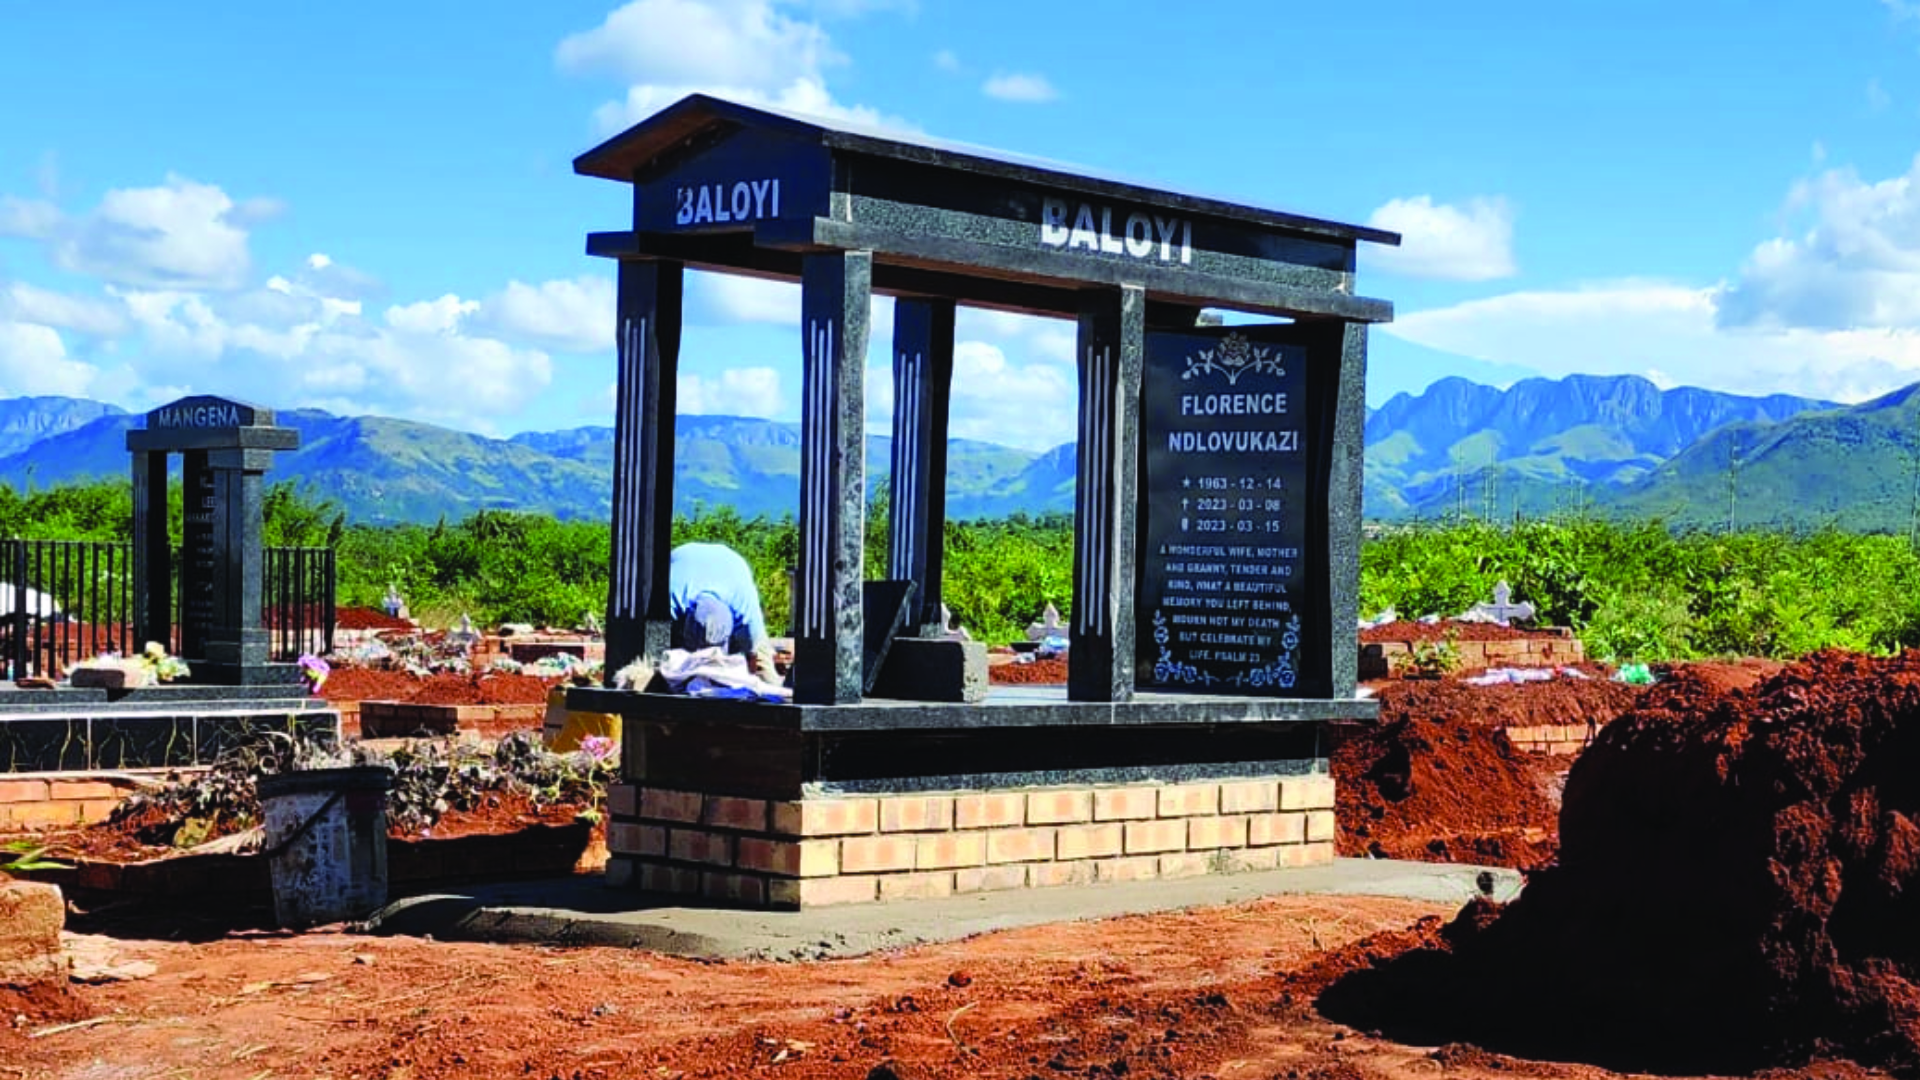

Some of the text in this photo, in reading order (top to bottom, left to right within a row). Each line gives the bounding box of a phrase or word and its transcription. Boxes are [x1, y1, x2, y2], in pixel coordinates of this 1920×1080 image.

[677, 179, 779, 225] BALOYI
[1042, 200, 1192, 264] BALOYI
[1181, 393, 1287, 415] FLORENCE
[158, 405, 239, 427] MANGENA
[1168, 430, 1298, 451] NDLOVUKAZI
[1199, 477, 1227, 490] 1963
[1239, 477, 1254, 490] 12
[1267, 478, 1281, 490] 14
[1197, 498, 1227, 511] 2023
[1238, 498, 1253, 511] 03
[1197, 519, 1226, 532] 2023
[1238, 520, 1253, 532] 03
[1266, 520, 1280, 532] 15
[1159, 544, 1298, 558] A WONDERFUL WIFE, MOTHER
[1165, 563, 1184, 573] AND
[1230, 564, 1268, 575] TENDER
[1271, 565, 1292, 576] AND
[1196, 581, 1223, 591] WHAT
[1224, 582, 1231, 591] A
[1233, 582, 1287, 593] BEAUTIFUL
[1162, 597, 1292, 612] MEMORY YOU LEFT BEHIND,
[1172, 614, 1280, 629] MOURN NOT MY DEATH
[1179, 631, 1272, 646] BUT CELEBRATE MY
[1214, 651, 1247, 662] PSALM
